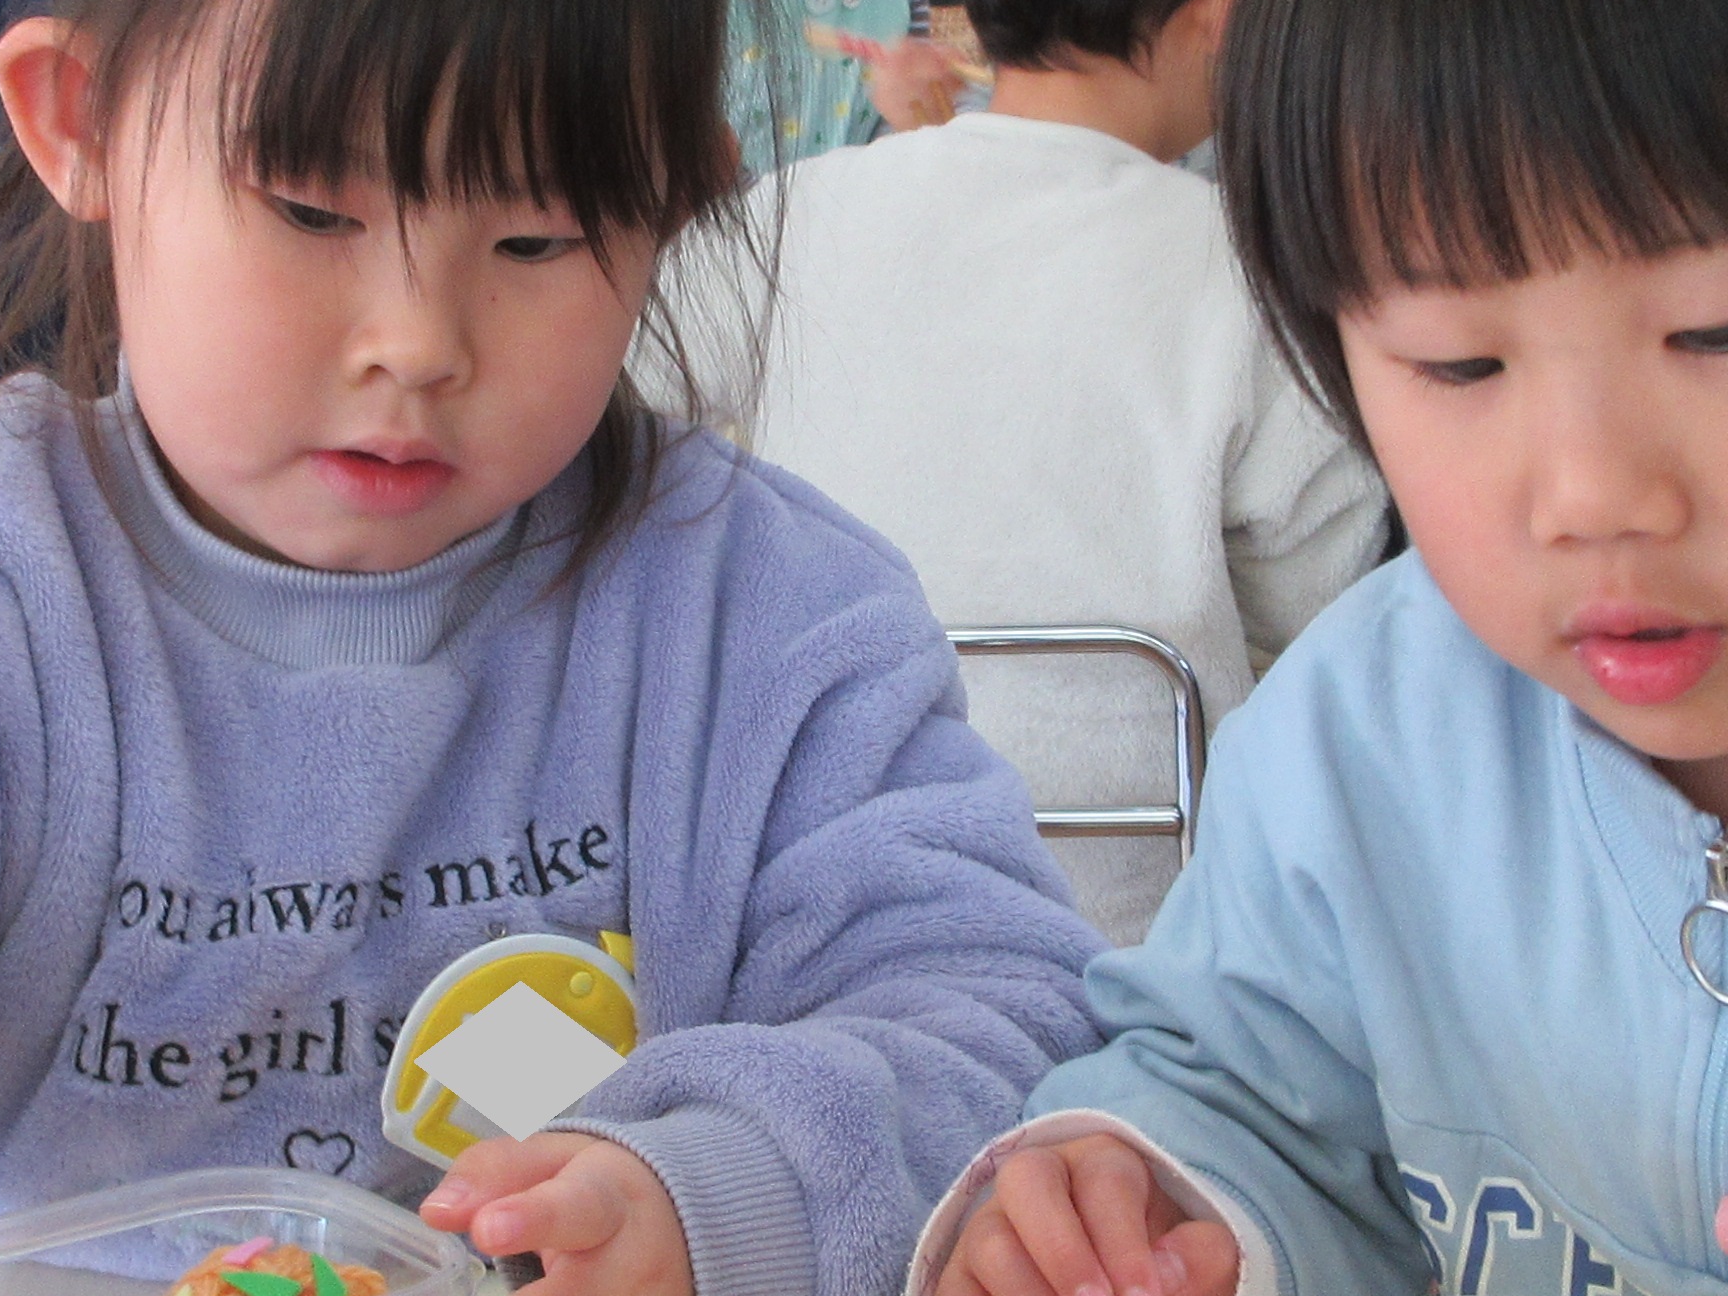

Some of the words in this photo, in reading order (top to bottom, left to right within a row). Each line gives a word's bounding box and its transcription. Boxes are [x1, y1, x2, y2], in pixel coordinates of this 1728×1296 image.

[116, 878, 192, 943] ou
[207, 866, 404, 944] alwas
[425, 819, 610, 907] make
[74, 1003, 191, 1089] the
[218, 999, 346, 1102] girl
